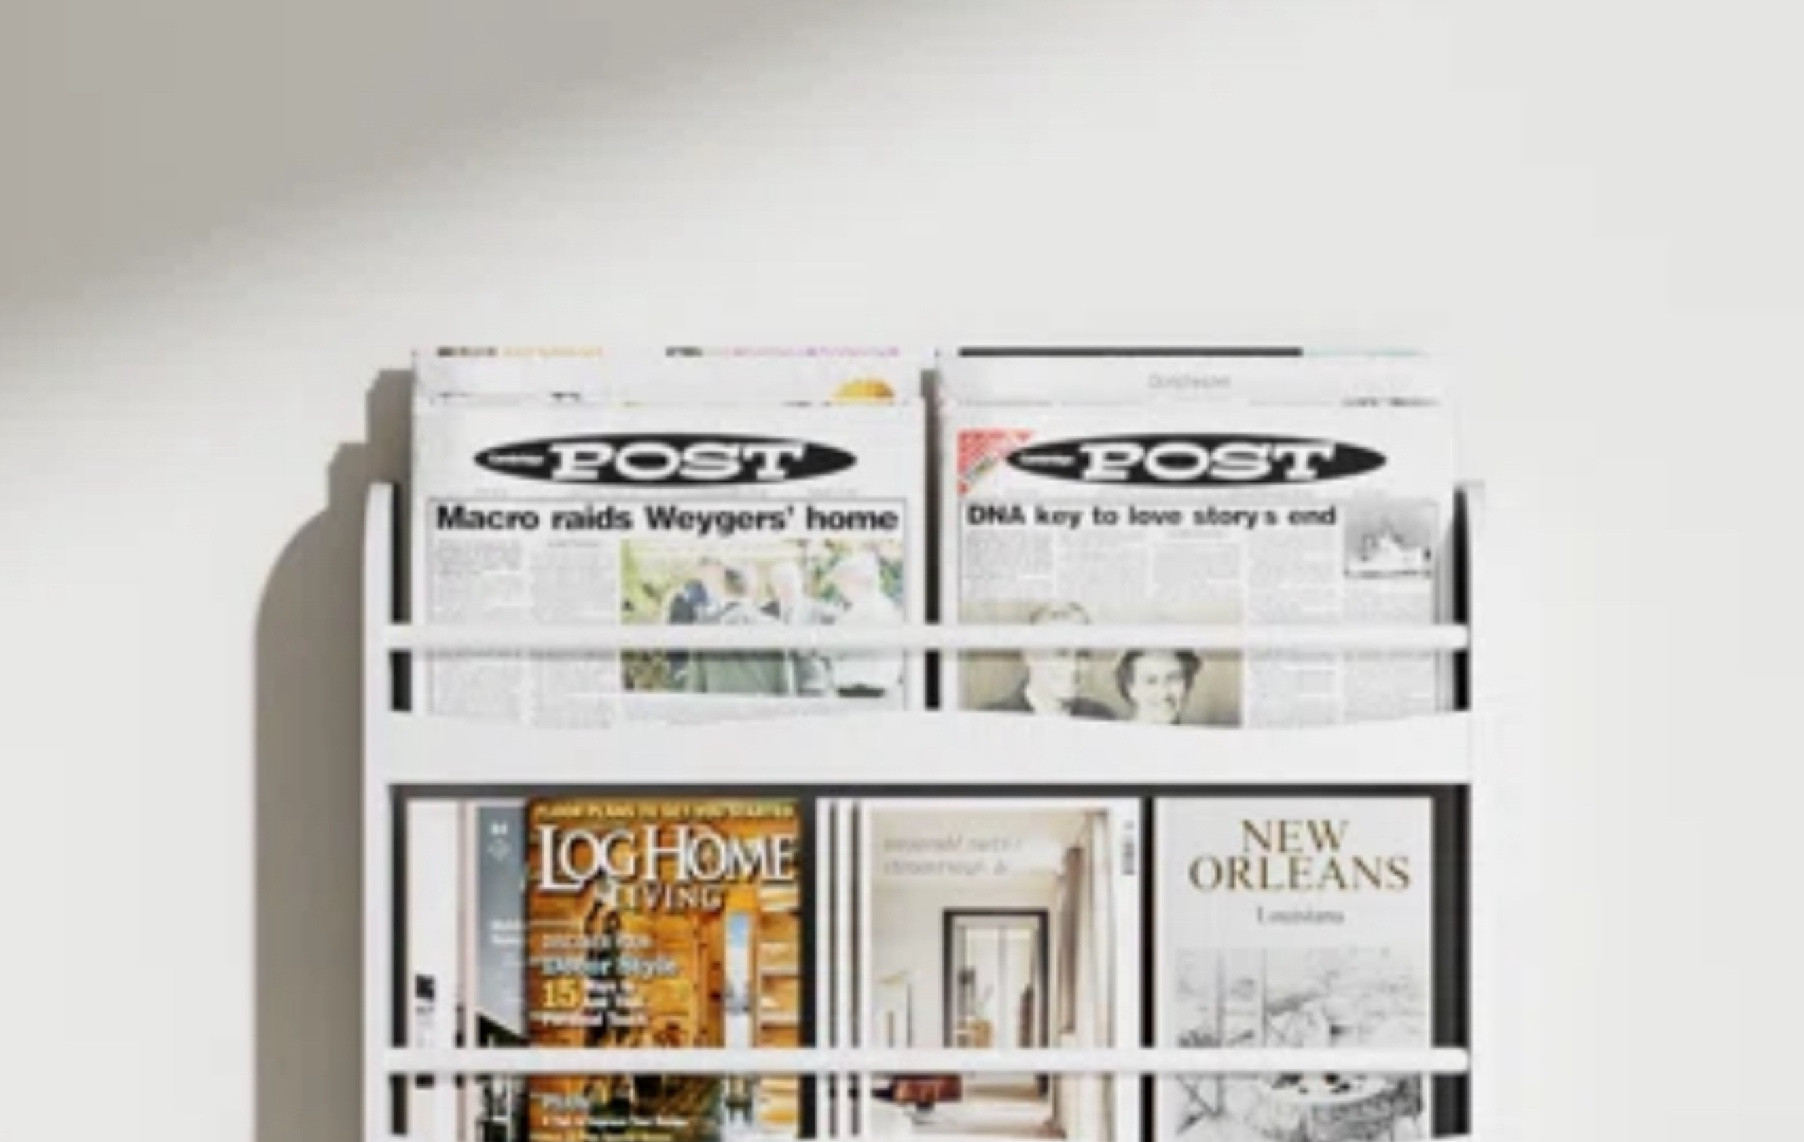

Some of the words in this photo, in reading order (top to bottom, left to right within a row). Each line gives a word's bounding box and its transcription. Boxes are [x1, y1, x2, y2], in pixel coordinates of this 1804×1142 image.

[549, 441, 804, 482] POST
[1079, 441, 1336, 482] POST
[435, 504, 540, 531] Macro
[551, 505, 634, 531] raids
[644, 505, 795, 536] Weygers'
[806, 505, 899, 531] home
[966, 504, 1026, 526] DNA
[1034, 505, 1084, 530] key
[1092, 505, 1119, 526] to
[1128, 504, 1182, 526] love
[1287, 504, 1337, 526] end
[1242, 818, 1348, 853] NEW
[1188, 856, 1411, 891] ORLEANS
[1256, 906, 1345, 925] Louisiana
[543, 979, 579, 1008] 15
